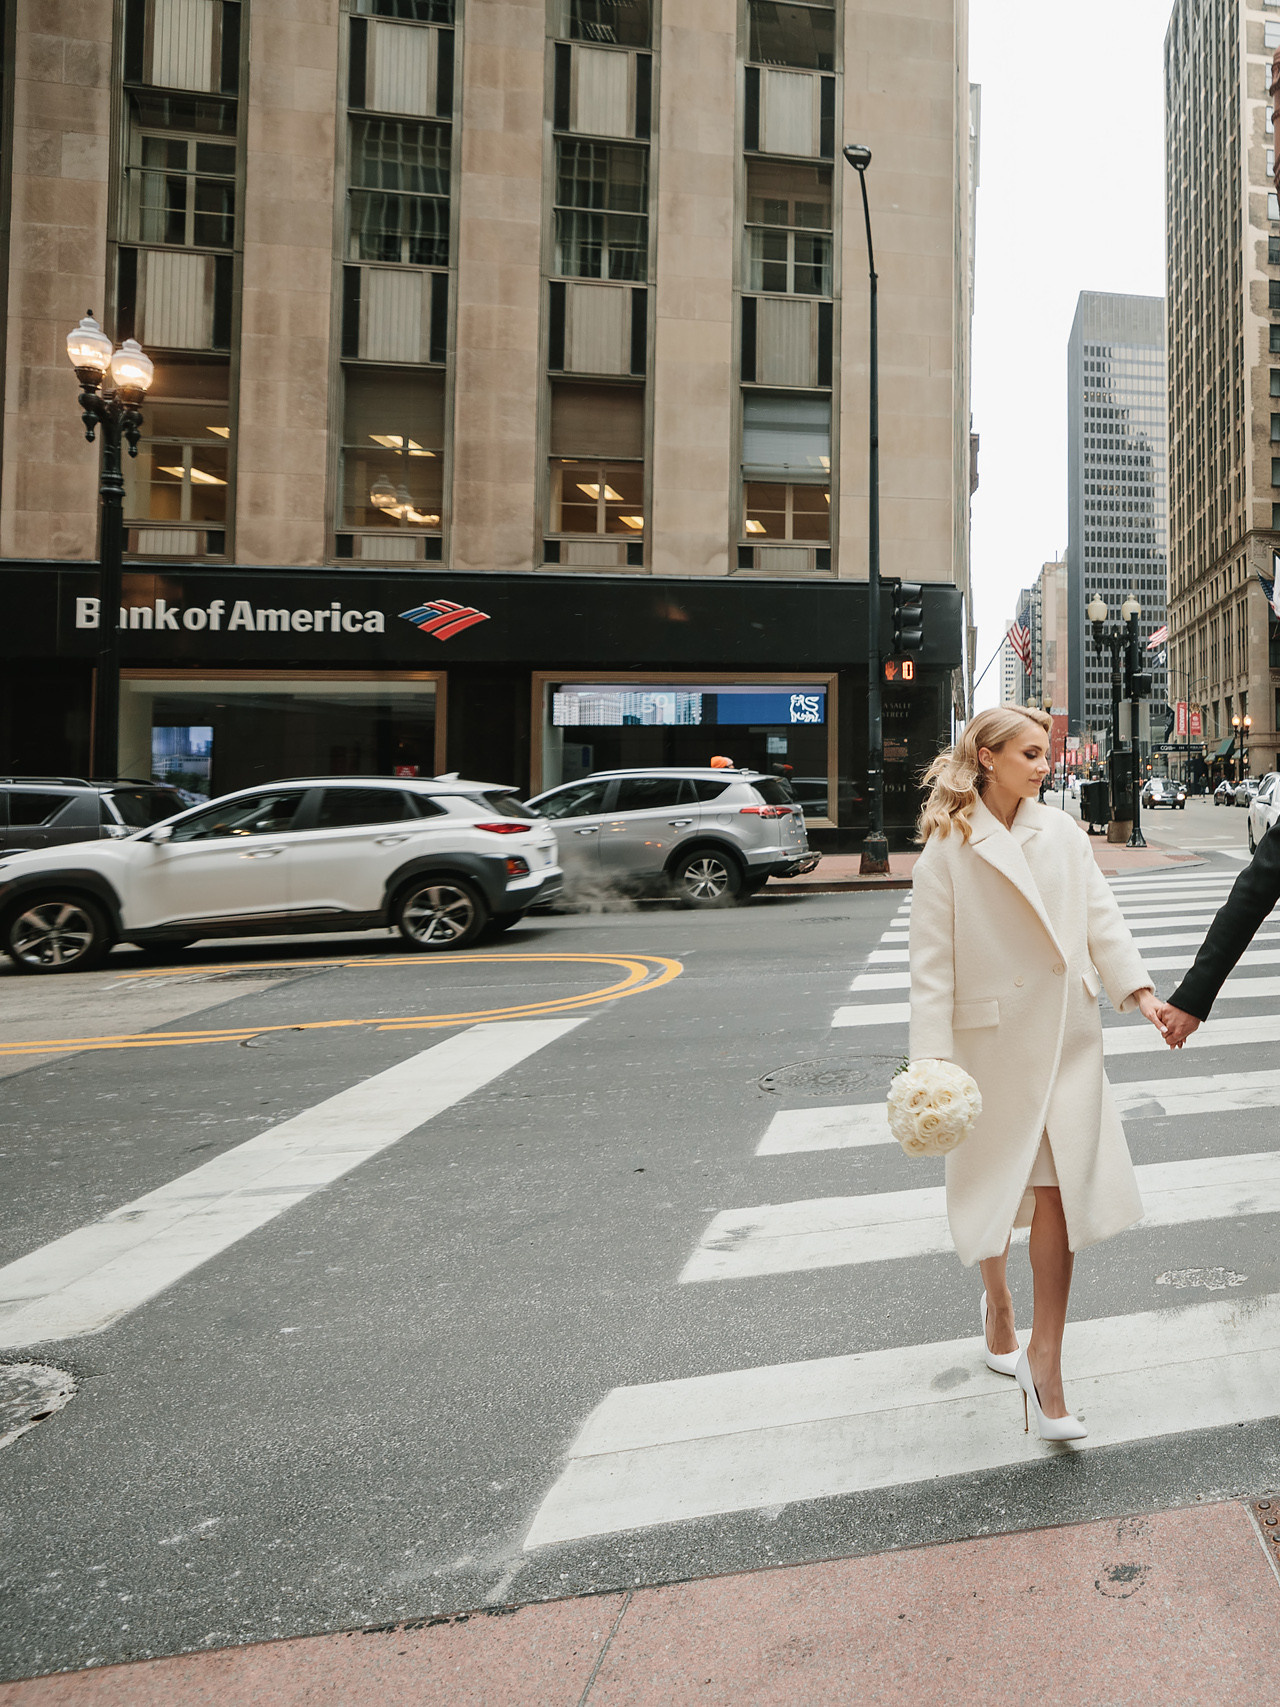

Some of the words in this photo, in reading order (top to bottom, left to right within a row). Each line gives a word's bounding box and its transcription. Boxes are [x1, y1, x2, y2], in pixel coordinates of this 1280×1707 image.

[75, 597, 180, 629] Bnk
[182, 600, 226, 630] of
[227, 600, 385, 633] America
